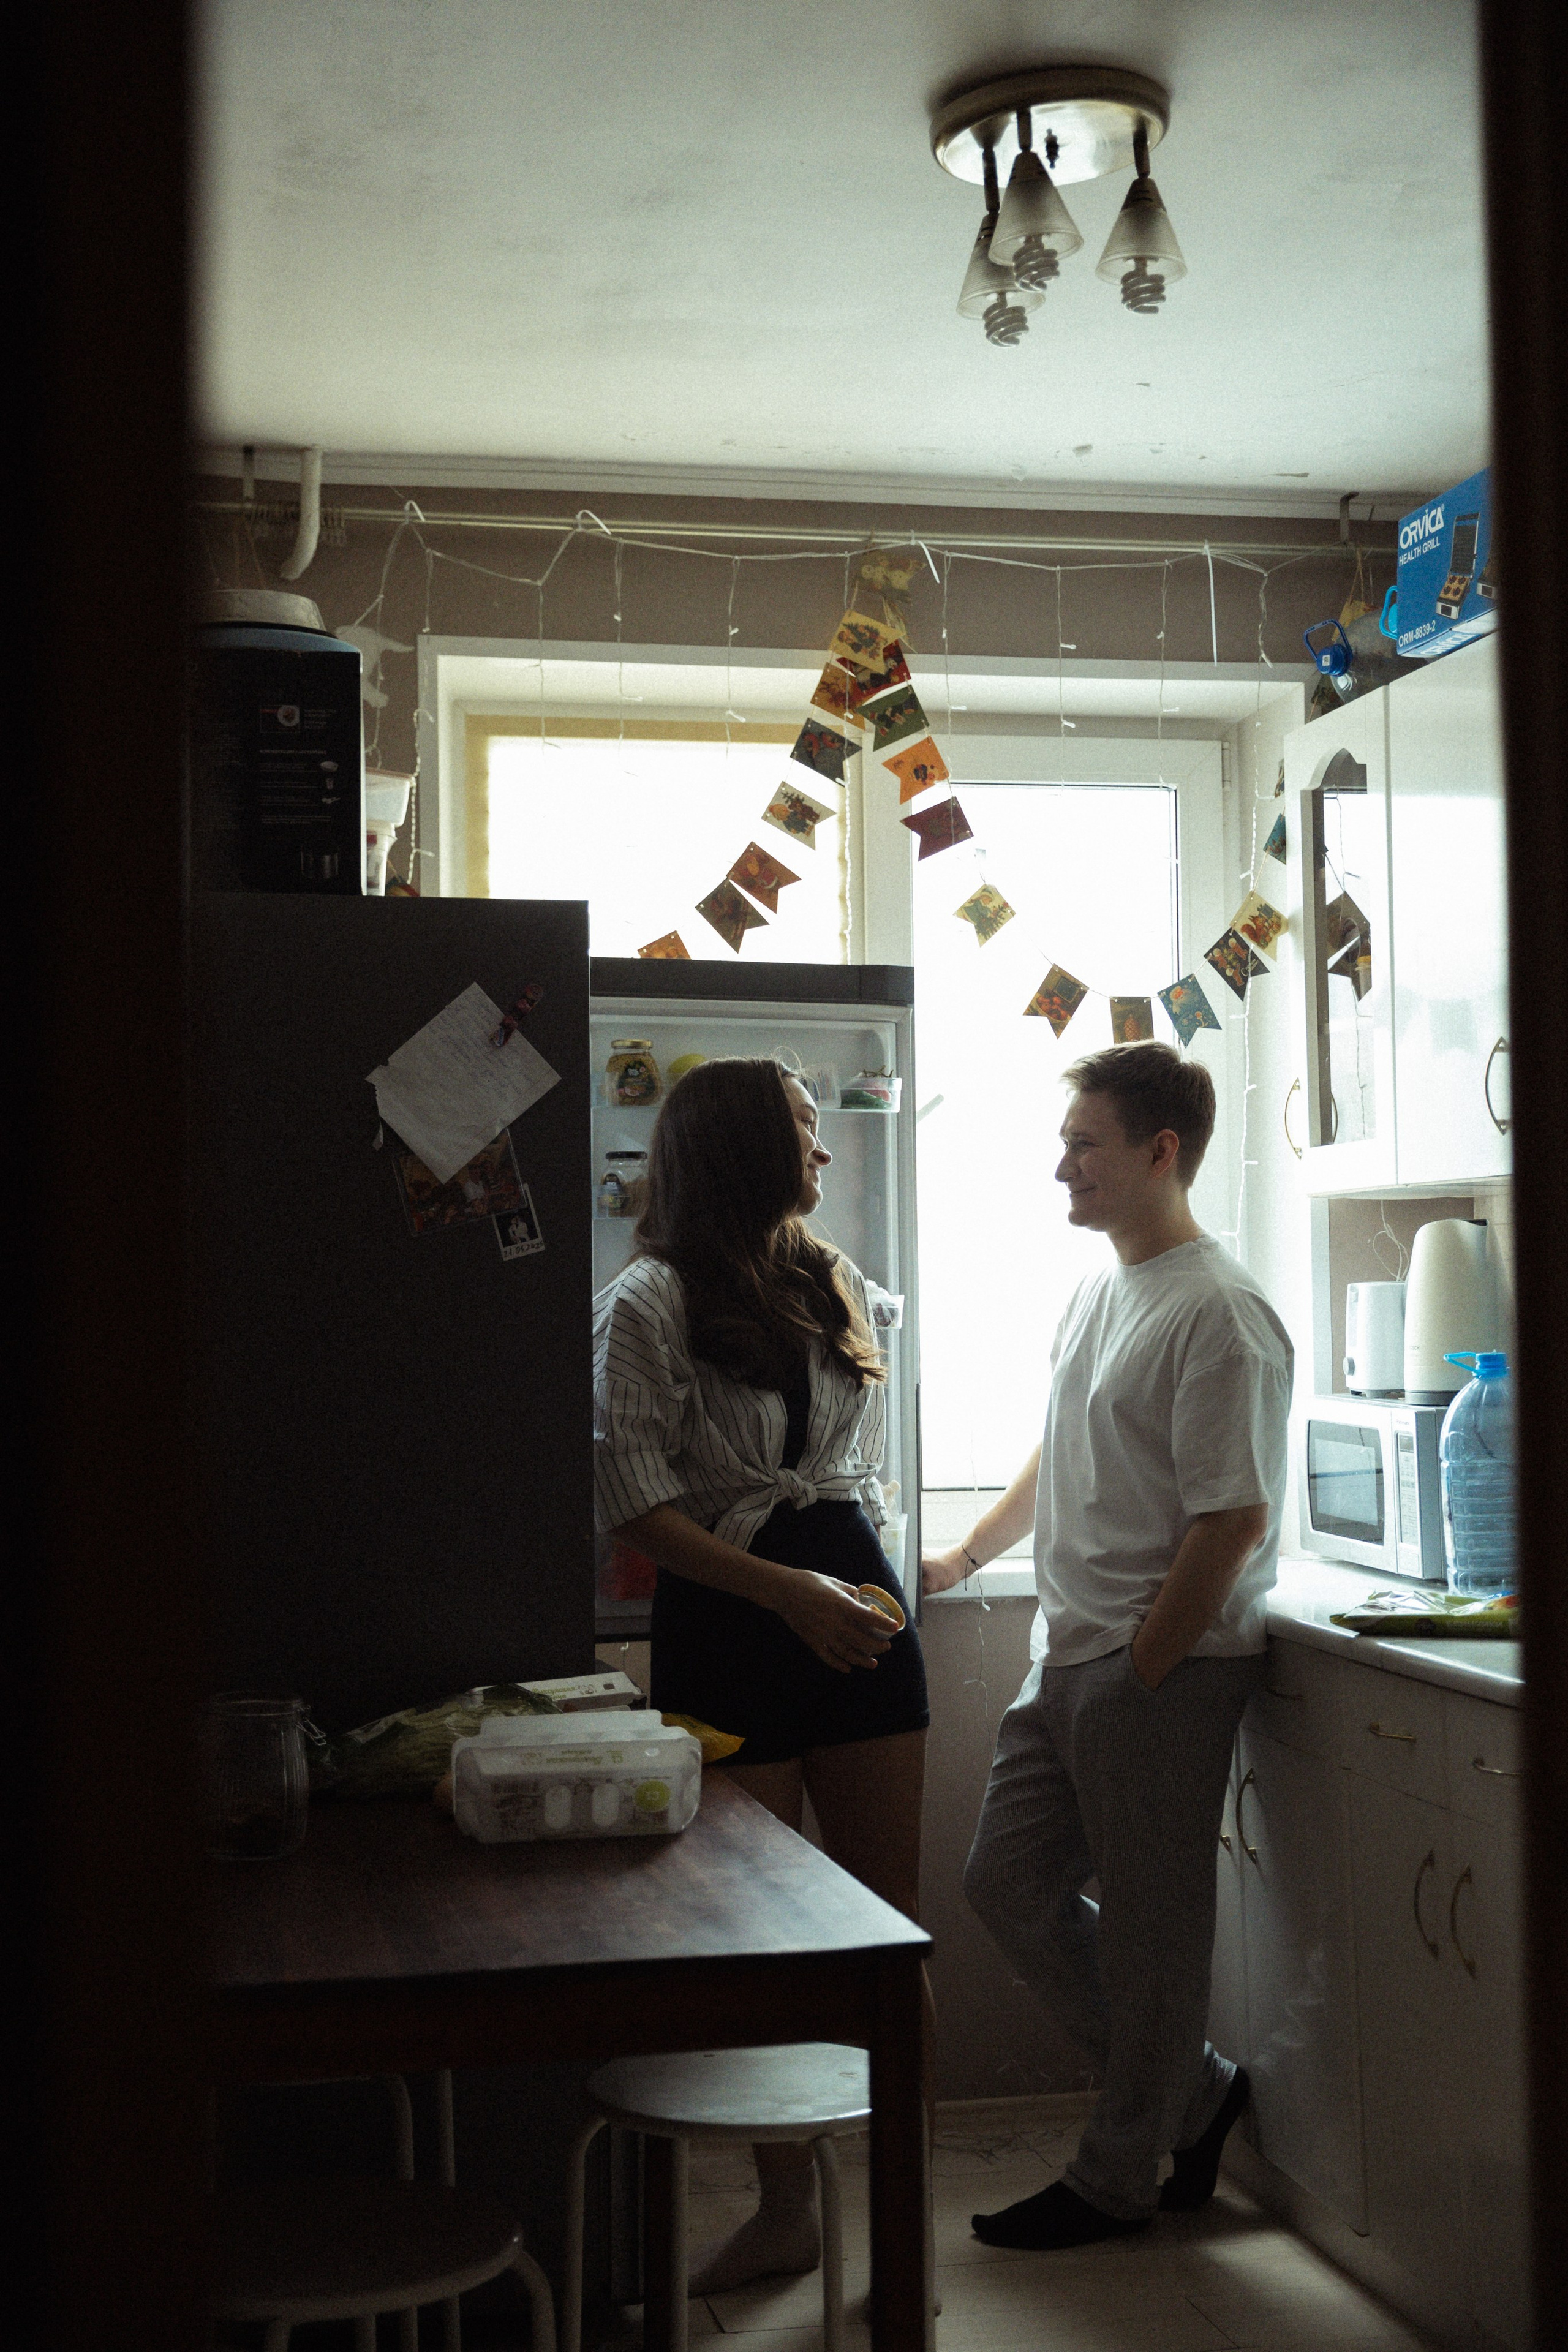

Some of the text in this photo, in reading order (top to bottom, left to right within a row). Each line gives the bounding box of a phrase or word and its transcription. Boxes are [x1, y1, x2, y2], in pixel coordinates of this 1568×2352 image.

[1398, 536, 1441, 567] HEALTH GRILL
[1398, 620, 1436, 647] ORM-8839-2
